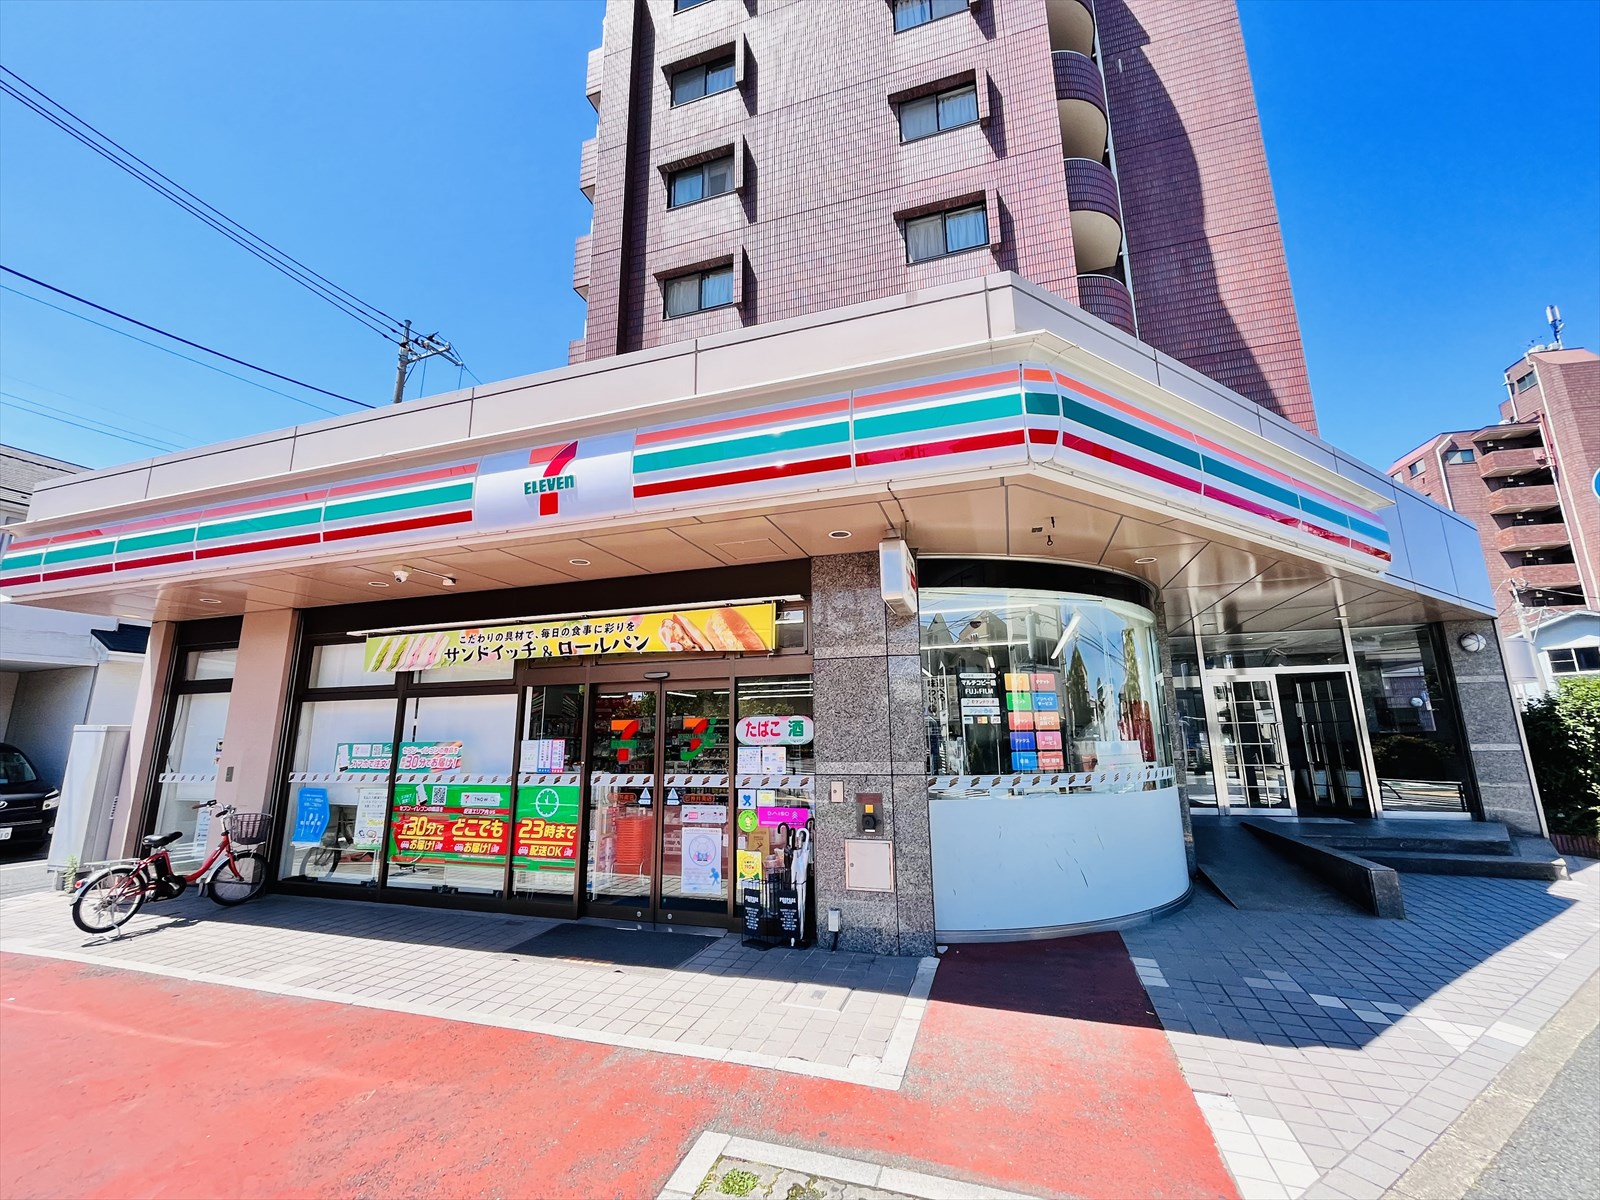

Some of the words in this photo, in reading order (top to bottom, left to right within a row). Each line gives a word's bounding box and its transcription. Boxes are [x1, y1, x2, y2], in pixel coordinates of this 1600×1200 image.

[459, 621, 635, 644] こだわりの具材で、毎日の食事に彩りを
[444, 640, 537, 664] サンドイッチ
[542, 645, 553, 658] &
[558, 635, 650, 657] ロールパン
[745, 720, 781, 738] たばこ
[788, 720, 804, 737] 酒
[451, 818, 504, 838] どこでも
[518, 819, 577, 839] 23時まで
[409, 839, 435, 851] お届け!
[463, 842, 491, 853] お届け!
[529, 845, 563, 857] 配送OK
